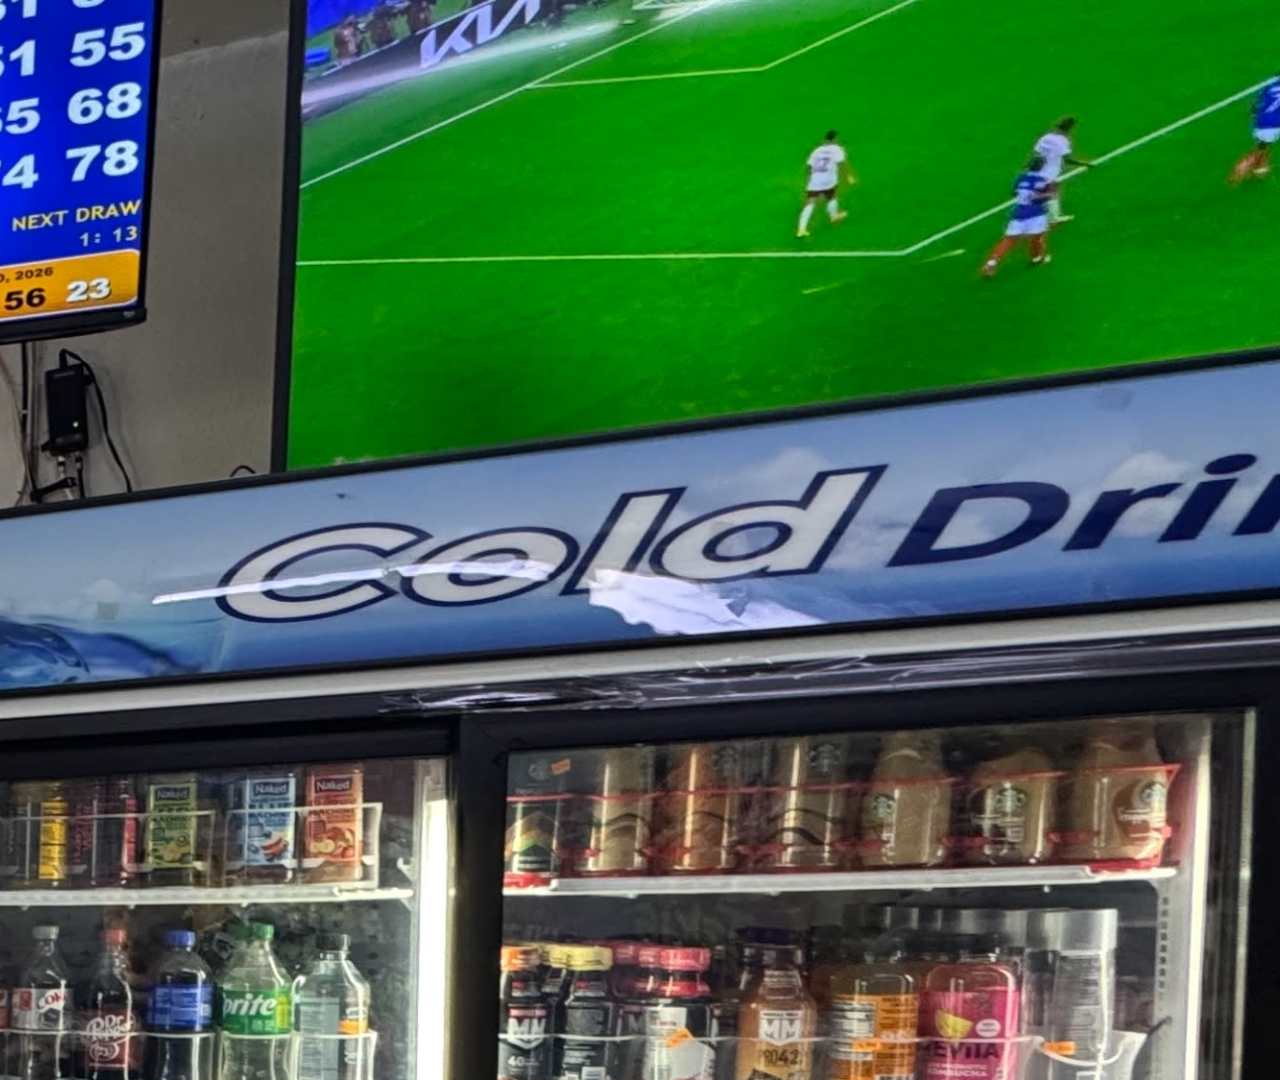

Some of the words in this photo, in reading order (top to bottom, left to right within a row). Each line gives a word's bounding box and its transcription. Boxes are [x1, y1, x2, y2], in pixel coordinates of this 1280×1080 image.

[70, 22, 145, 67] 55
[67, 82, 142, 124] 68
[66, 140, 138, 182] 78
[12, 210, 69, 232] NEXT
[76, 199, 141, 223] DRAW
[15, 267, 54, 281] 2026
[4, 288, 46, 311] 56
[66, 277, 112, 303] 23
[217, 464, 889, 623] Cold
[316, 780, 350, 790] Naked
